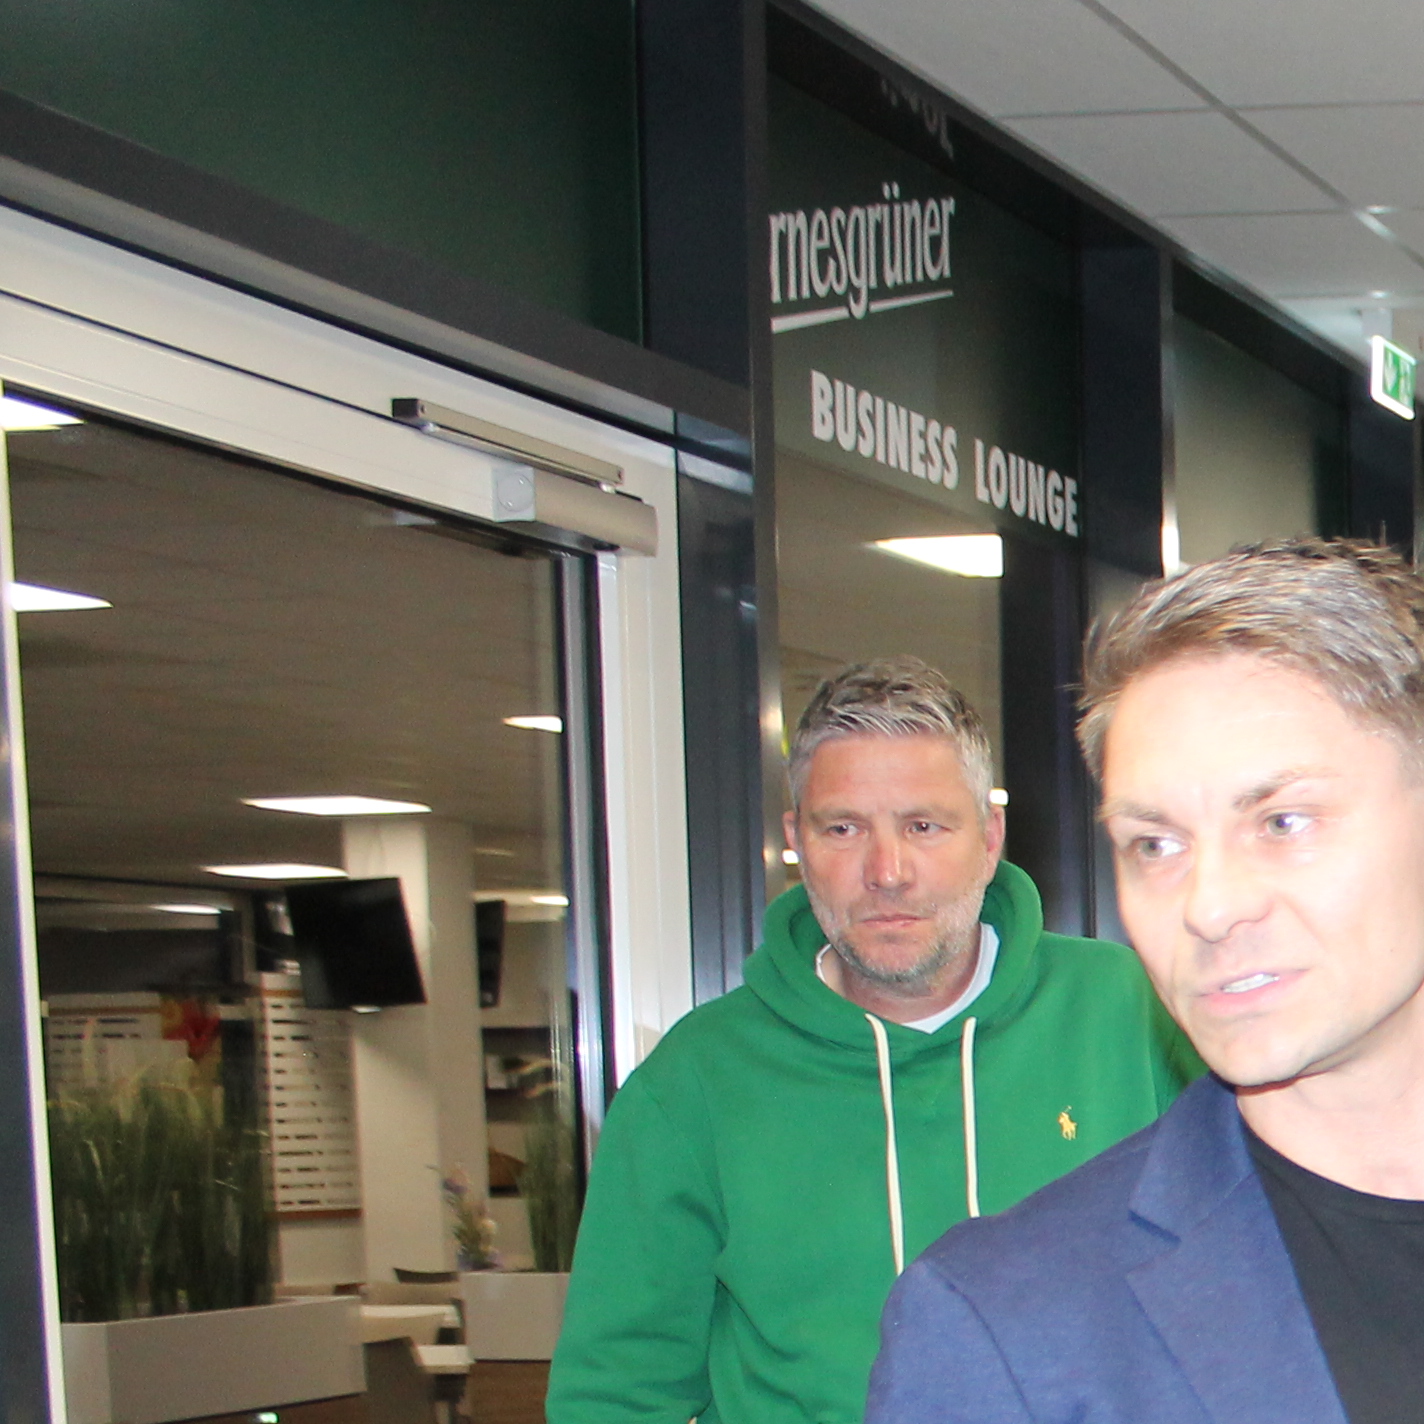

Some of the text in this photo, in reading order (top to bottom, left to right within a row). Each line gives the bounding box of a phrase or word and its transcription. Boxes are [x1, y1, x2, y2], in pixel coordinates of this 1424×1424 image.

[769, 181, 956, 319] rnesgrüner
[810, 369, 1079, 538] BUSINESS LOUNGE
